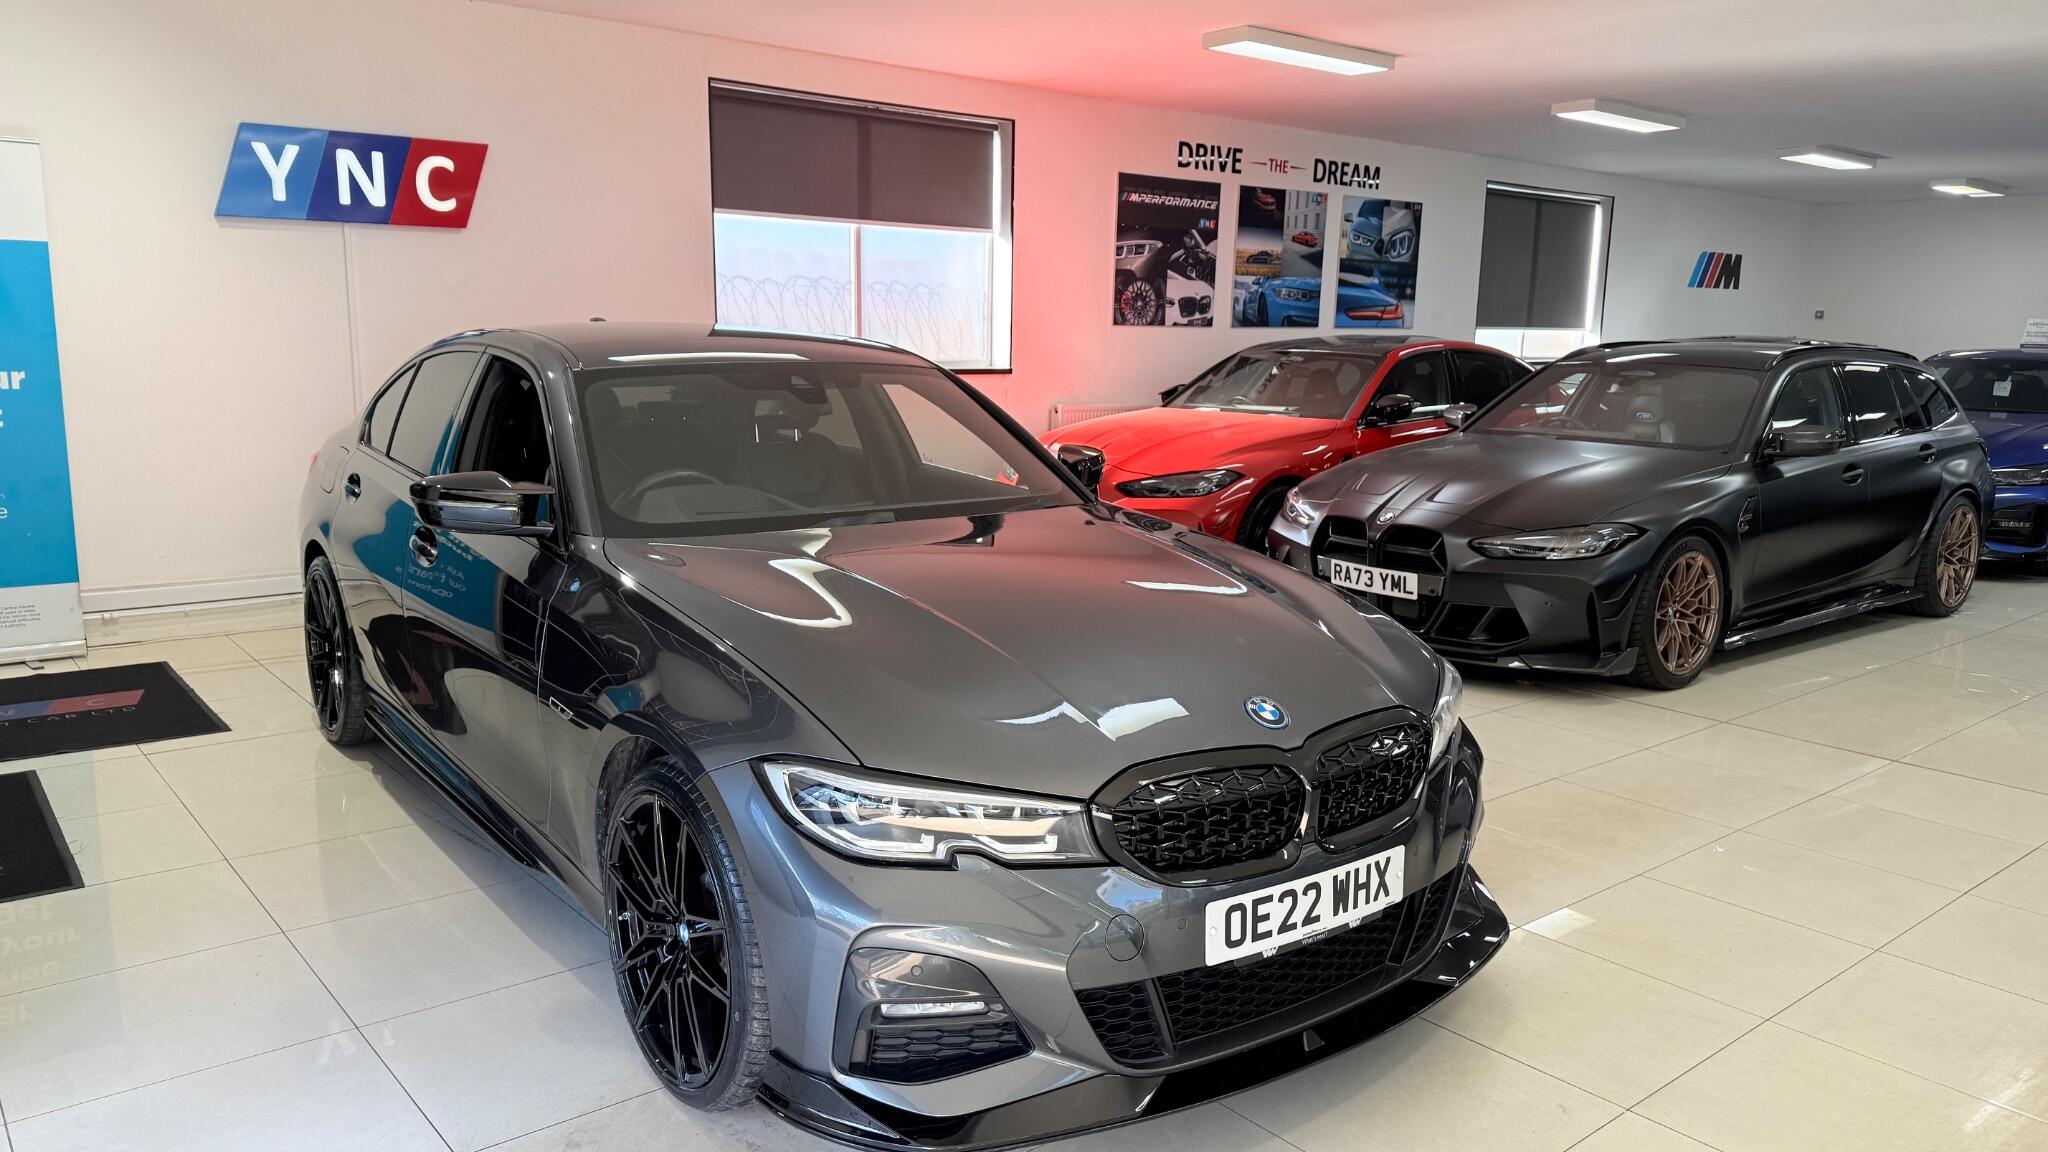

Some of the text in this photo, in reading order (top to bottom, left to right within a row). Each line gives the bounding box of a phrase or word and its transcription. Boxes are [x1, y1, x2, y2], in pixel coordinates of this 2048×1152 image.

[251, 141, 457, 212] YNC
[1178, 141, 1381, 190] DRIVE THE DREAM
[1334, 562, 1414, 595] RA73 YML
[1224, 855, 1392, 949] OE22 WHX
